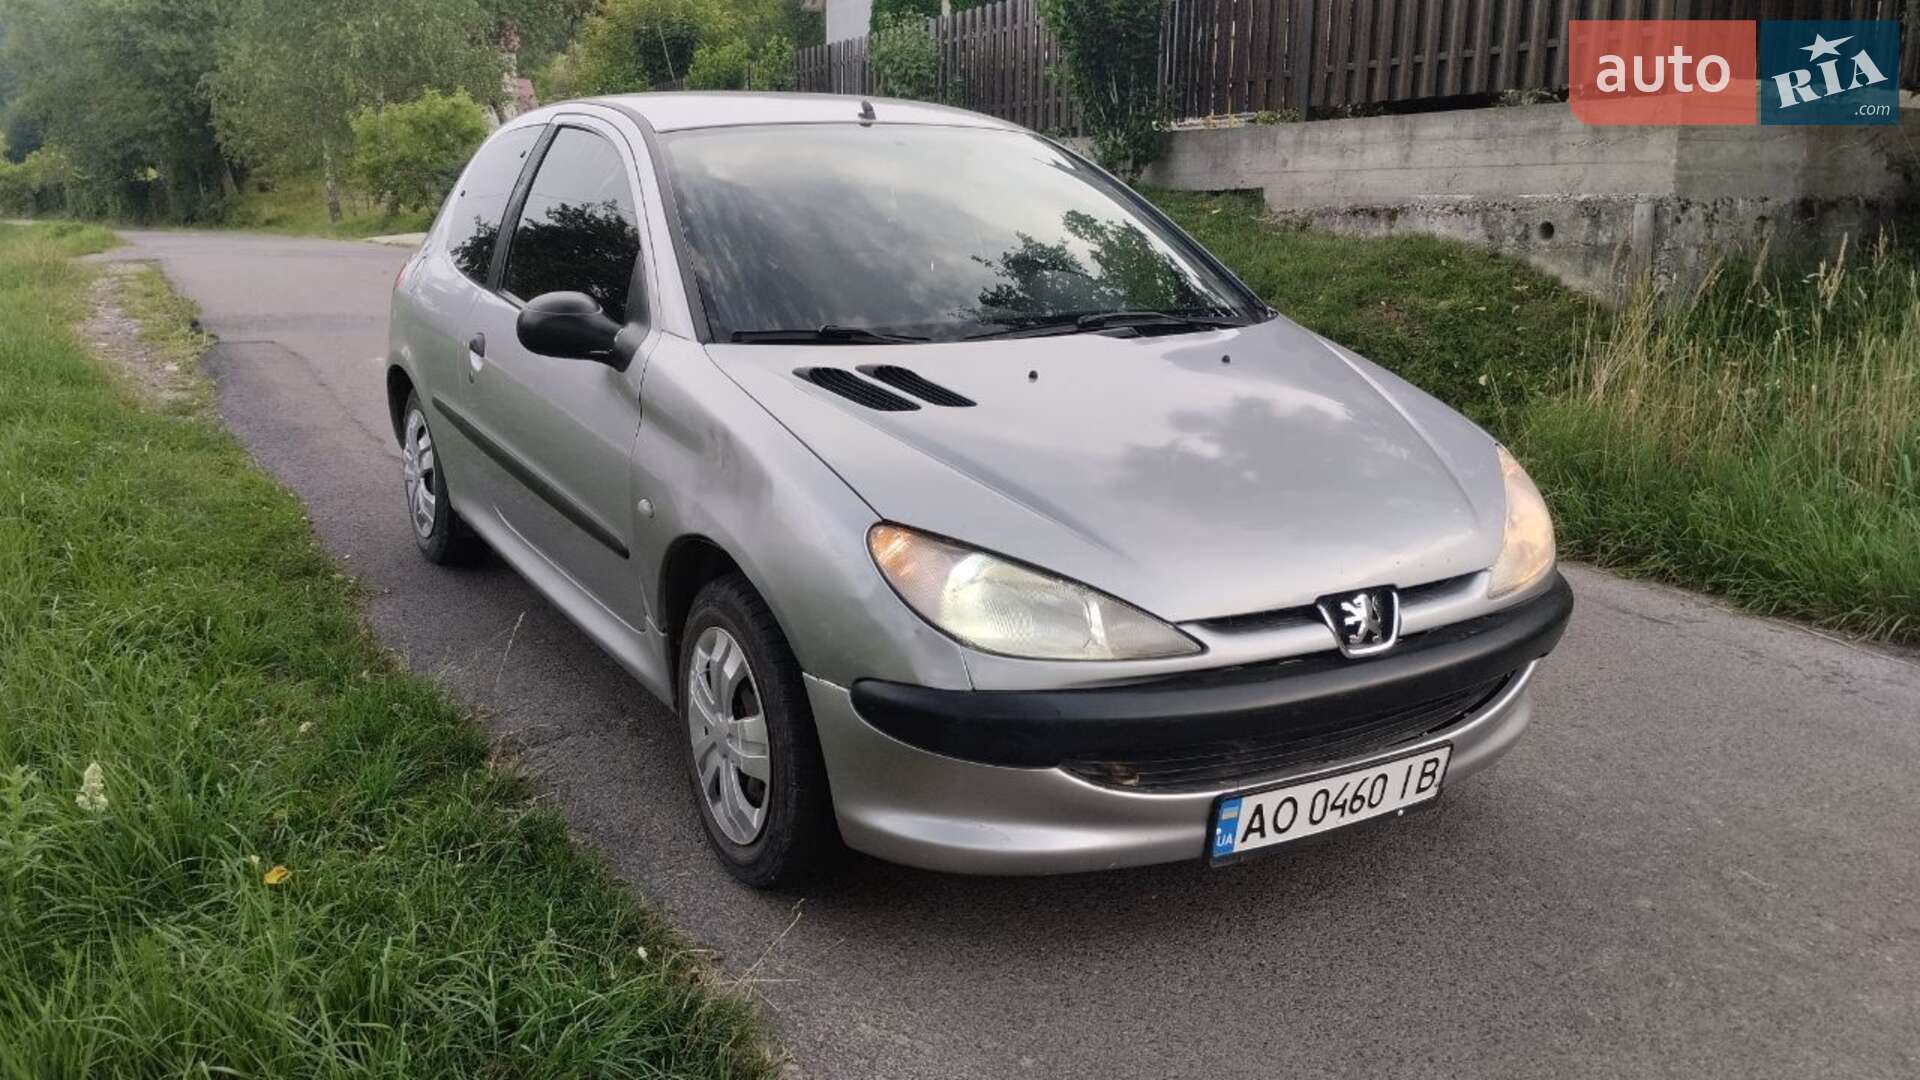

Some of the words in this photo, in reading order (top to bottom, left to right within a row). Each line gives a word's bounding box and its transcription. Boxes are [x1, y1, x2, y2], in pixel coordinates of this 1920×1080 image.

[1240, 796, 1299, 843] AO
[1308, 773, 1389, 826] 0460
[1400, 757, 1440, 800] IB
[1216, 832, 1234, 848] UA
